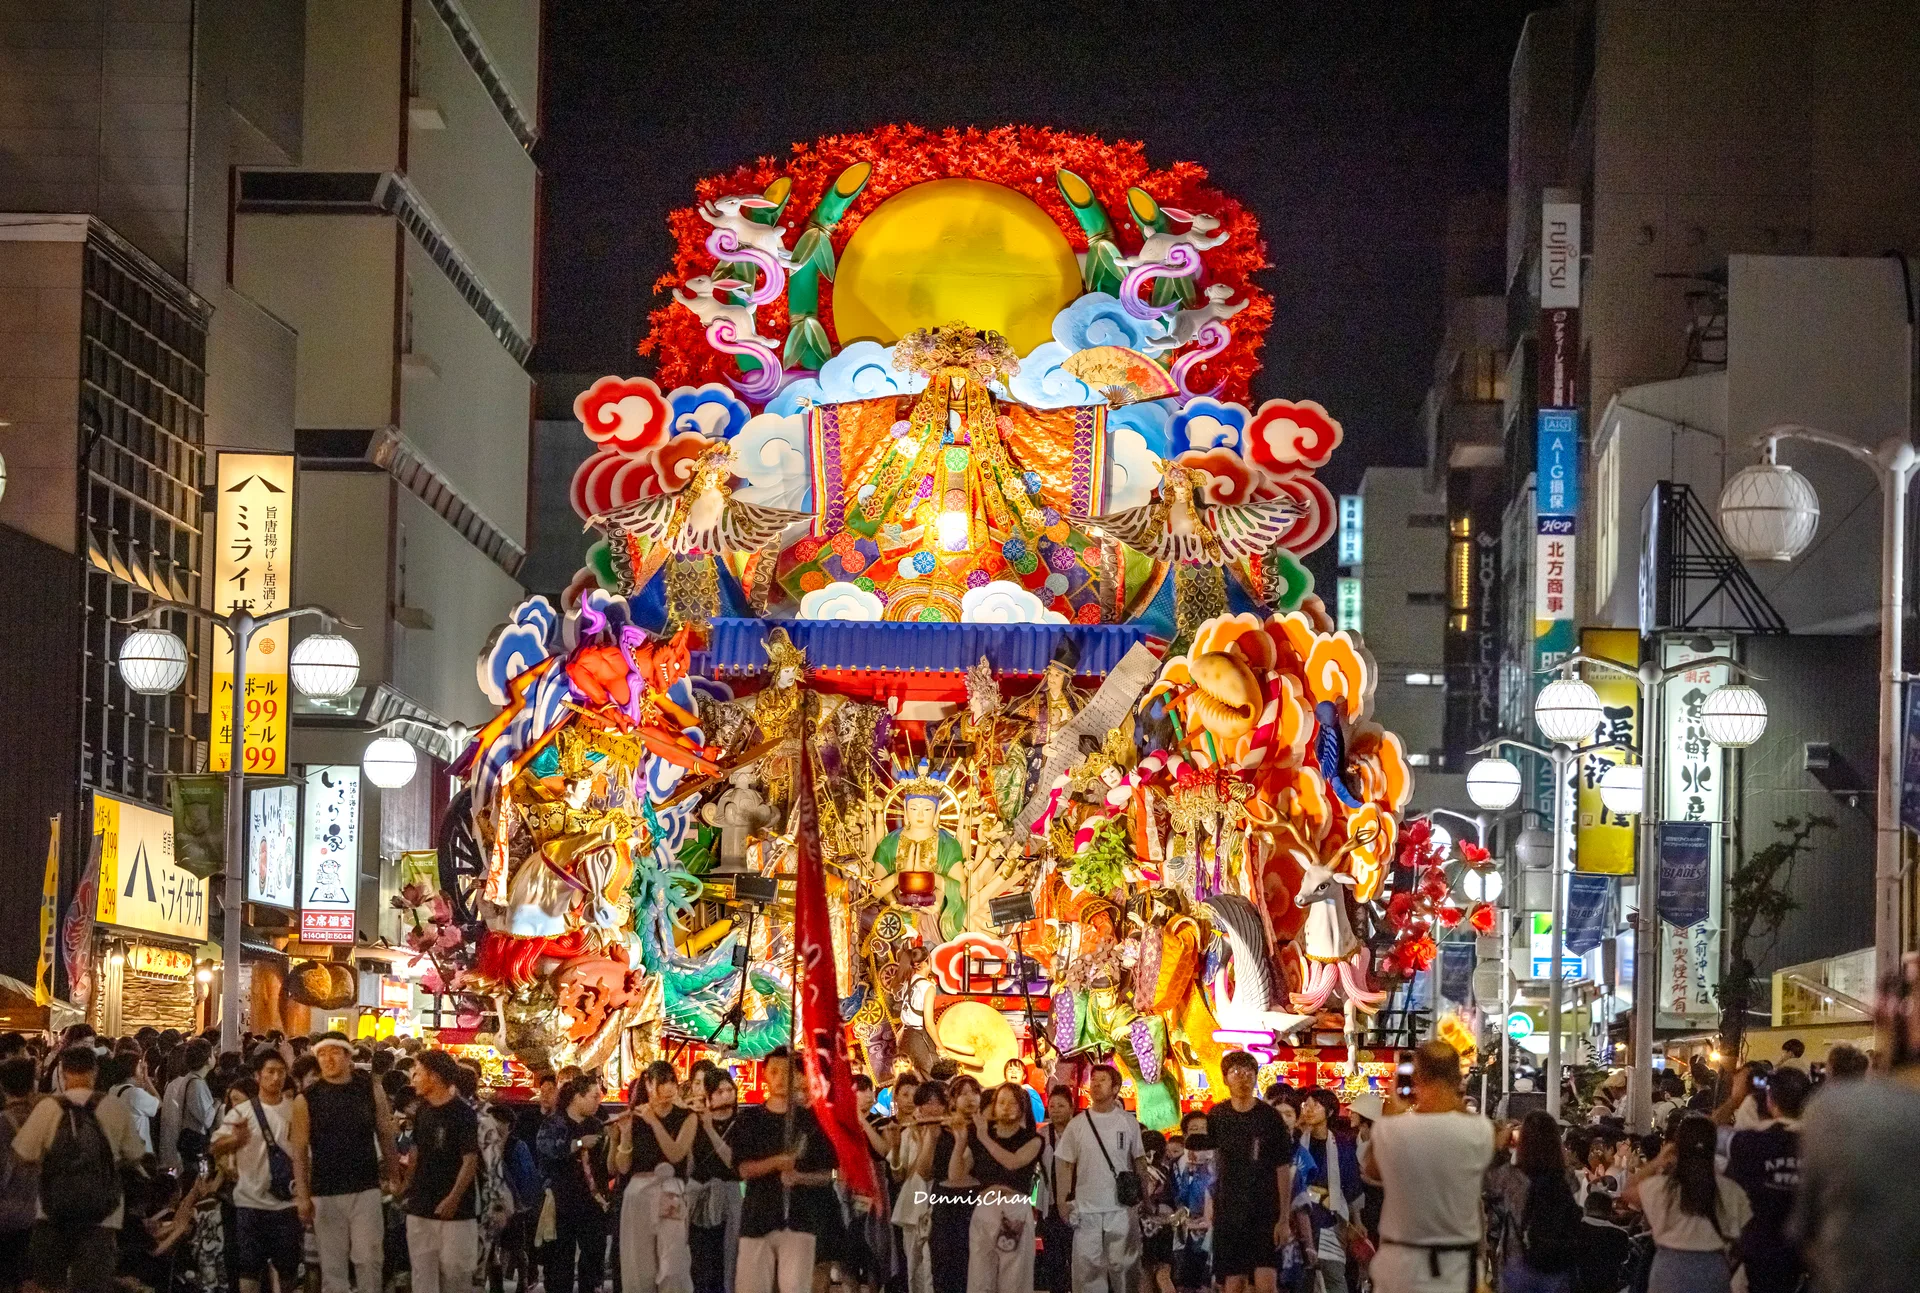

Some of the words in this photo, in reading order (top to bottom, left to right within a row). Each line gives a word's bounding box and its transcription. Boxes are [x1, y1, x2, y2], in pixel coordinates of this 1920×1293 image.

[1546, 221, 1566, 288] FUJITSU
[1548, 419, 1568, 429] AIG
[1549, 438, 1565, 509] AIG損保
[262, 505, 278, 614] 旨唐揚げと居酒メ
[1547, 541, 1564, 612] 北方商事
[220, 677, 278, 697] ハボール
[220, 699, 278, 723] ¥99
[219, 746, 276, 770] ¥99
[321, 771, 346, 852] いろり家
[1662, 868, 1704, 879] BLADES
[161, 869, 203, 927] ミライザカ
[304, 914, 352, 928] 全席個室
